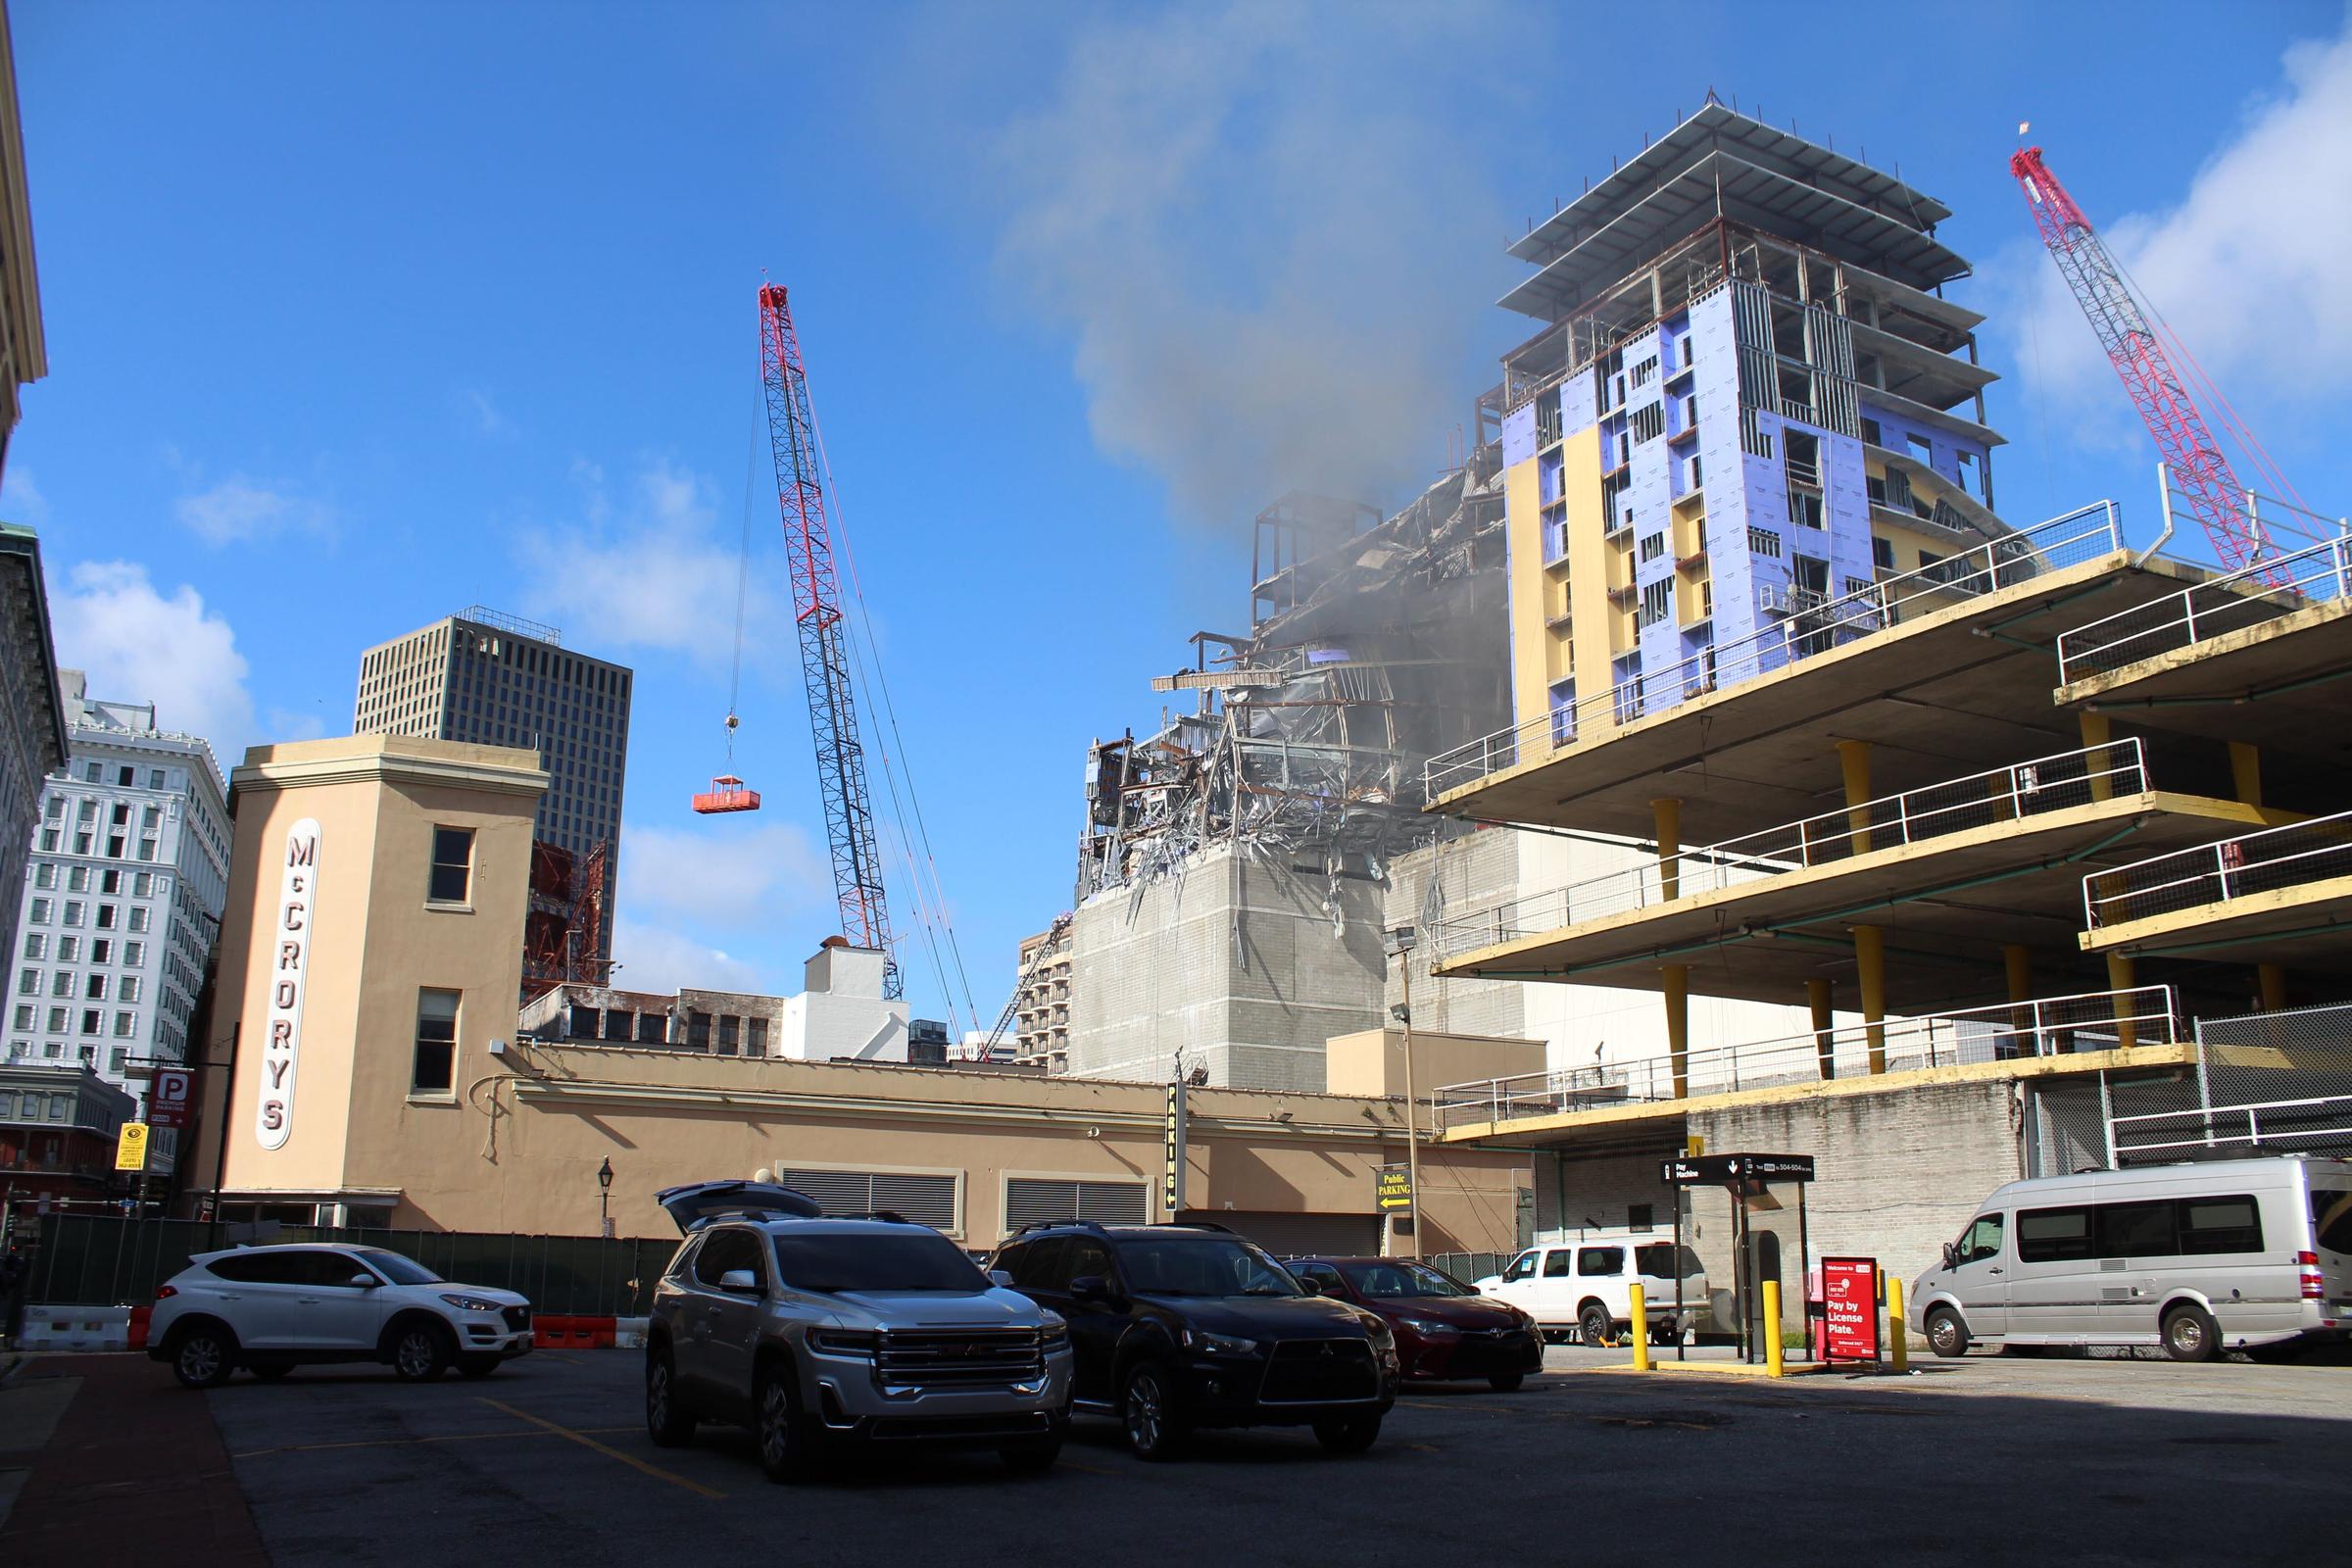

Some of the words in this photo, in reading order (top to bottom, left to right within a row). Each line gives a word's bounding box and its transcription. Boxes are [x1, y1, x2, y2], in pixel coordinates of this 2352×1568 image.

[1167, 1087, 1176, 1189] PARKING
[1384, 1174, 1405, 1184] Public
[1379, 1184, 1411, 1196] PARKING
[1828, 1300, 1843, 1311] Pay
[1846, 1300, 1858, 1312] by
[1828, 1312, 1863, 1323] License
[1828, 1323, 1854, 1334] Plate.
